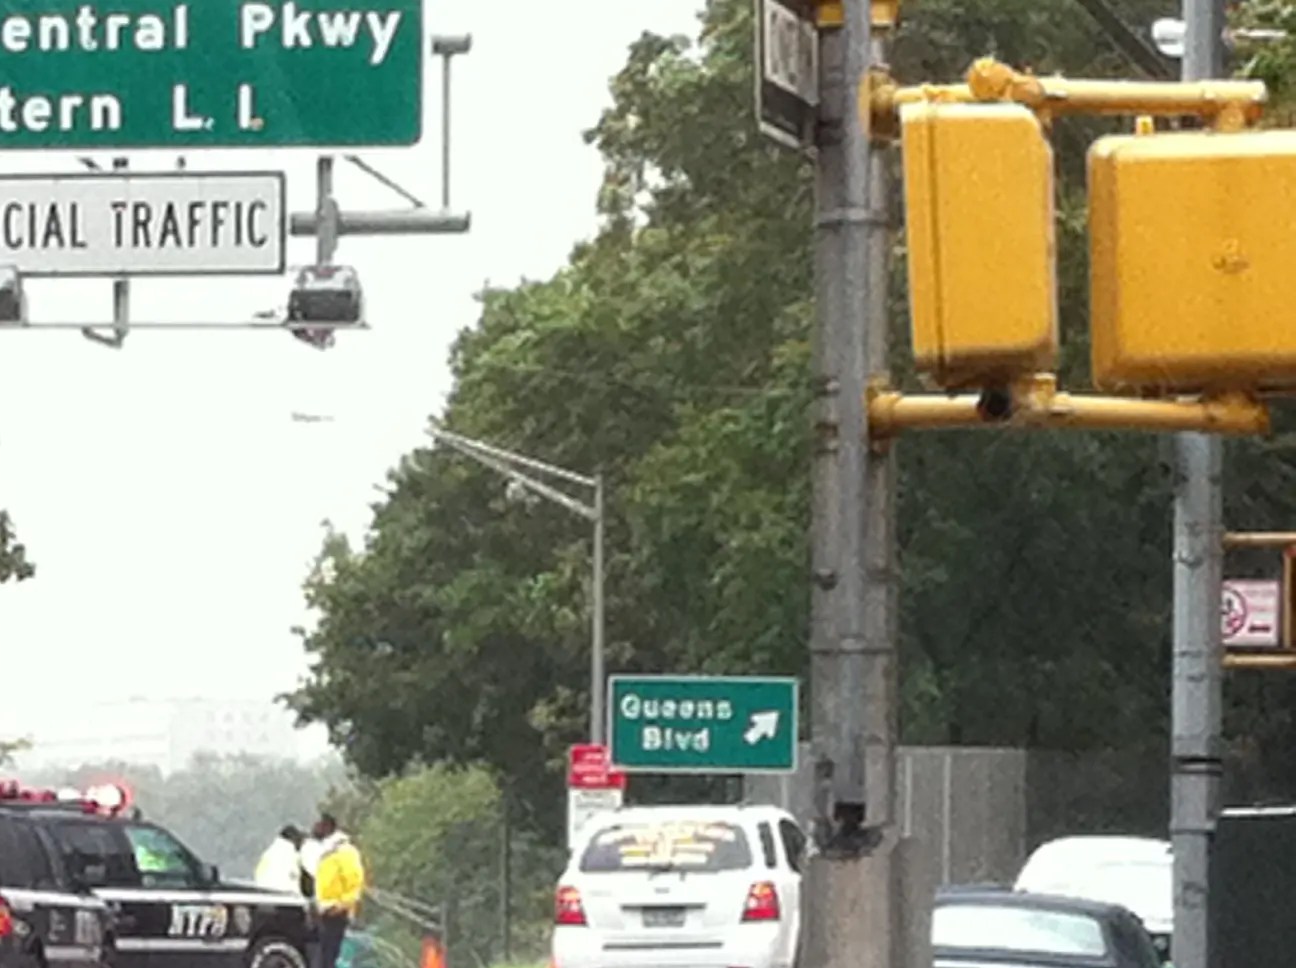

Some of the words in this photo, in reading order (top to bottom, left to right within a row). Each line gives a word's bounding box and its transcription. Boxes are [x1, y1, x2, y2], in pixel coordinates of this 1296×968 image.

[241, 1, 401, 65] Pkwy
[110, 201, 268, 248] TRAFFIC
[621, 693, 732, 719] Queens
[643, 726, 709, 752] Blvd
